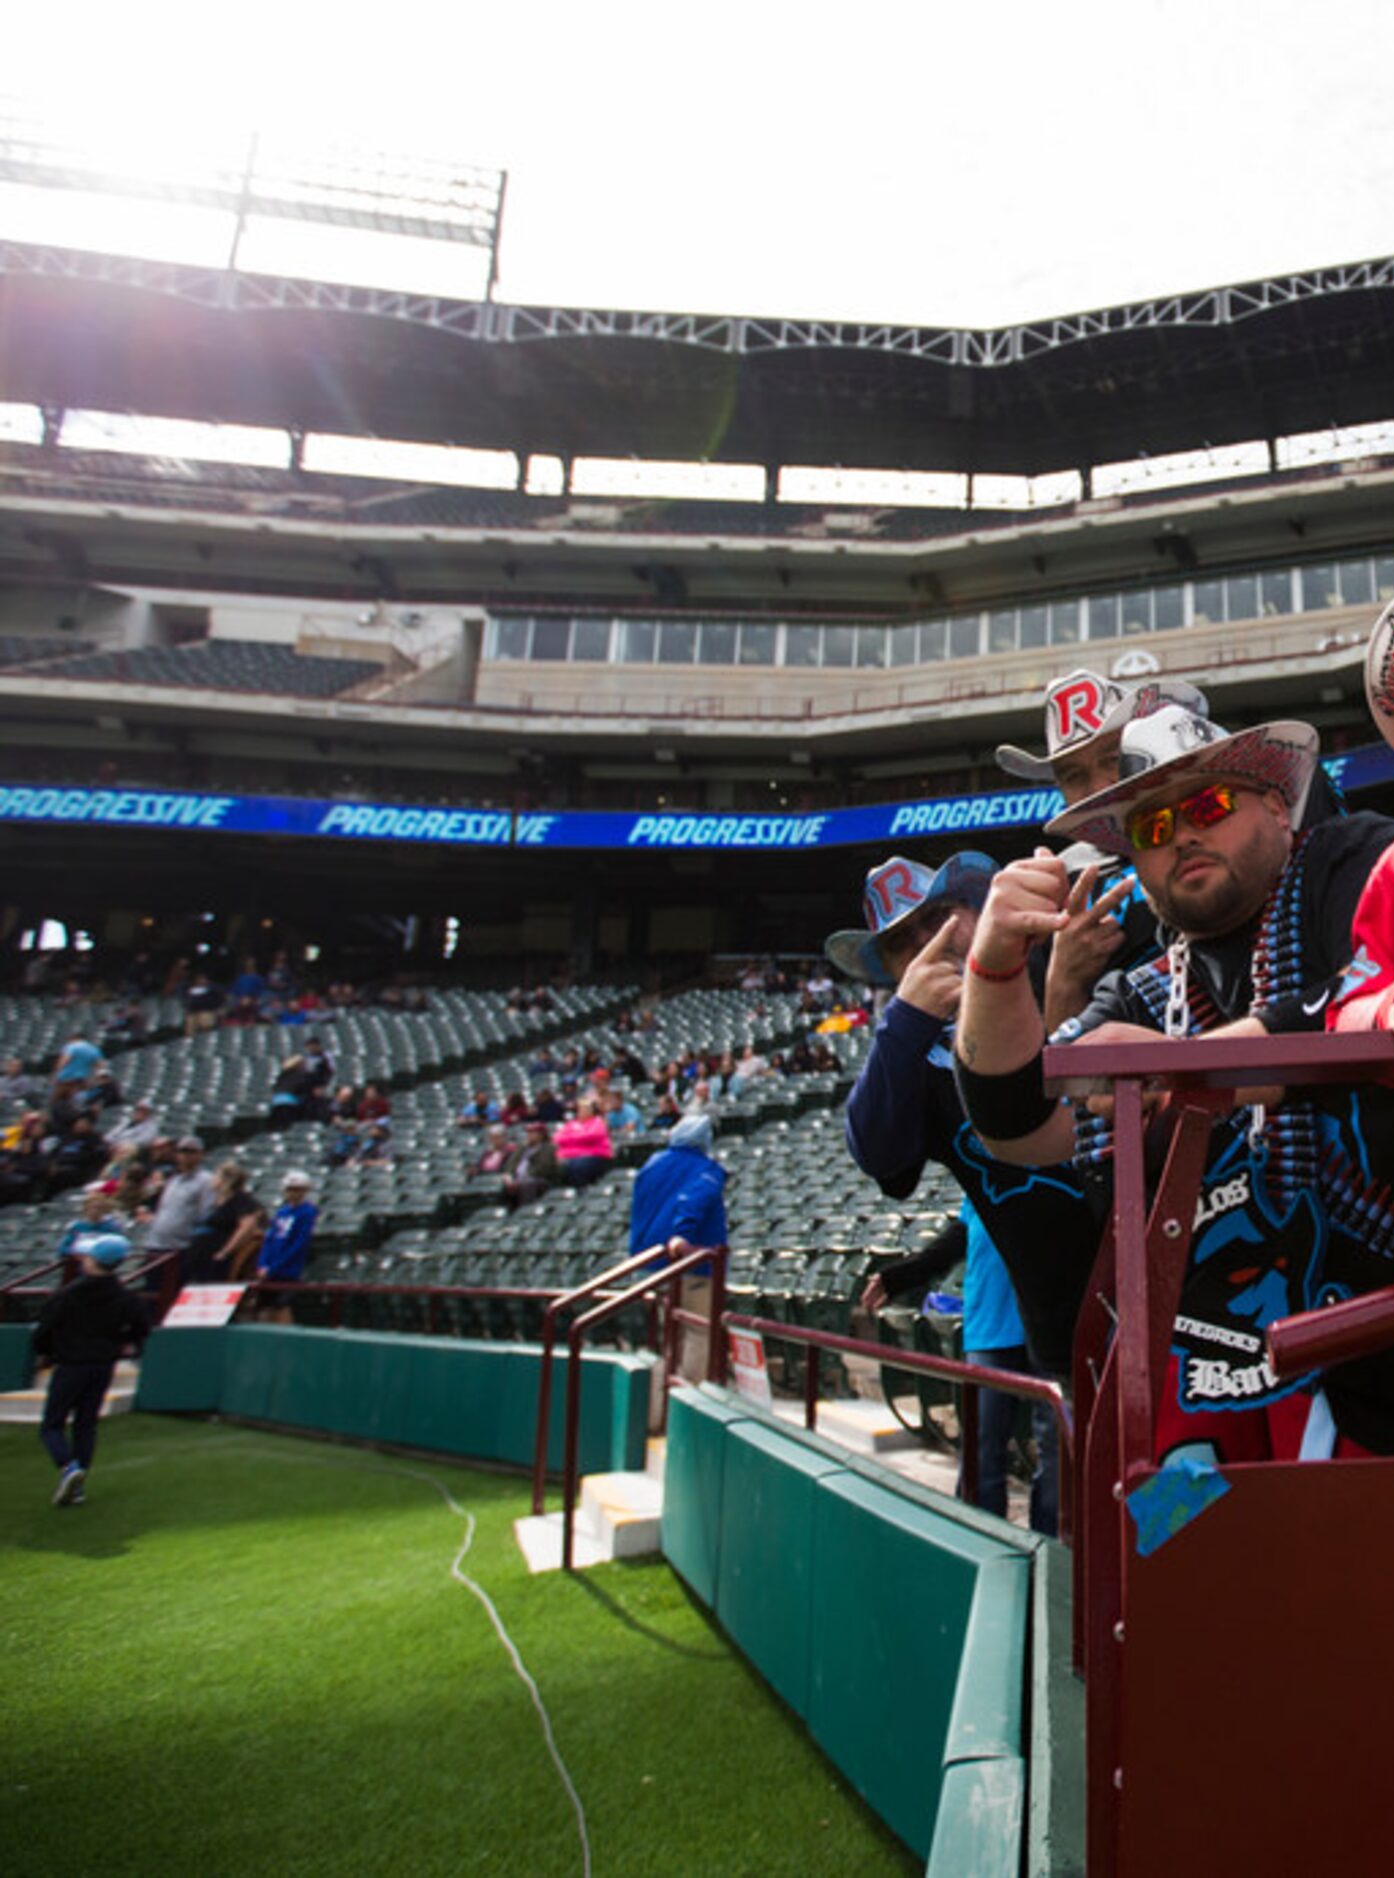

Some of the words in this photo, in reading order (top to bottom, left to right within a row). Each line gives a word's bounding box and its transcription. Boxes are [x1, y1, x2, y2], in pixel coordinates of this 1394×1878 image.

[1050, 676, 1104, 740] R
[317, 804, 552, 842] PROGRESSIVE
[627, 815, 827, 845] PROGRESSIVE
[870, 862, 925, 916] R
